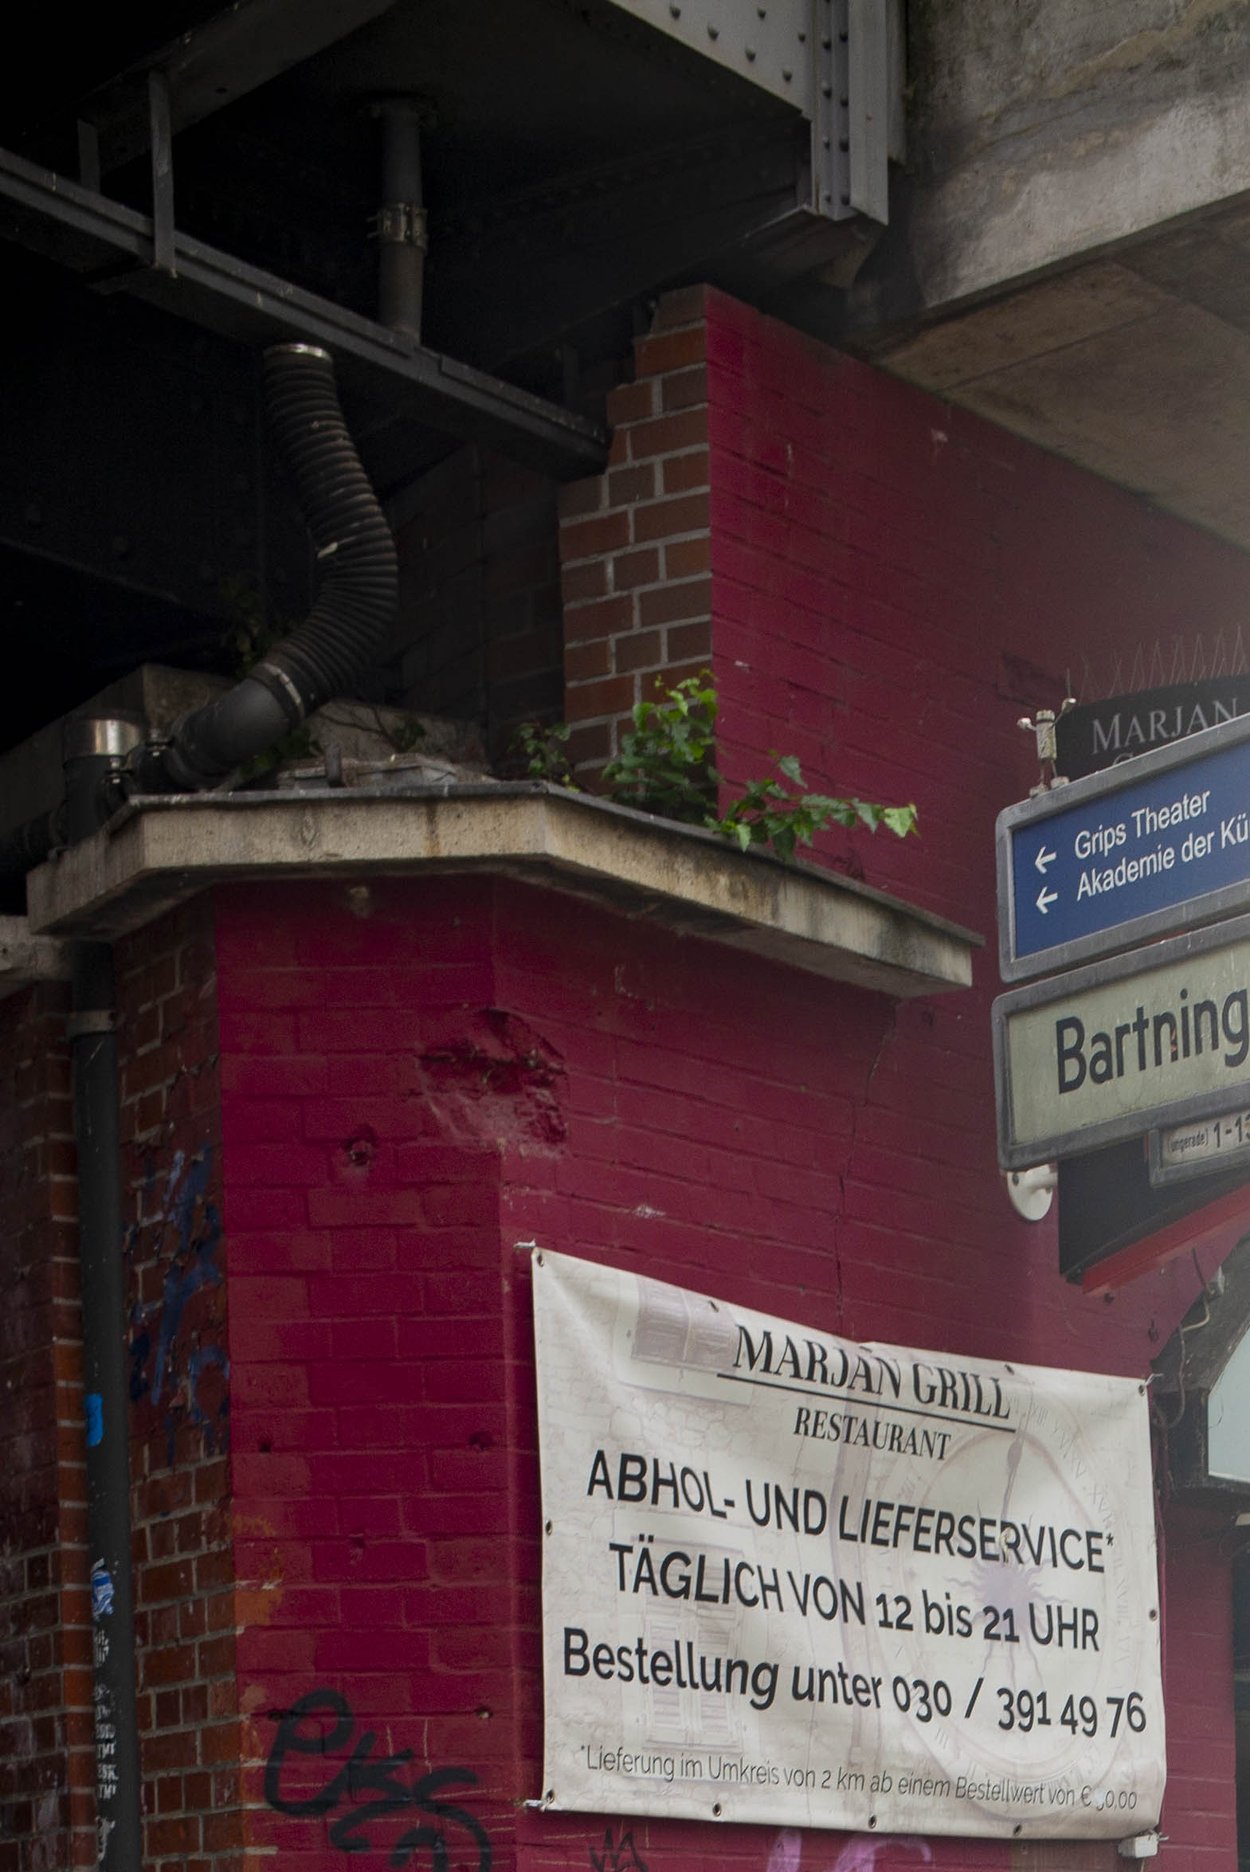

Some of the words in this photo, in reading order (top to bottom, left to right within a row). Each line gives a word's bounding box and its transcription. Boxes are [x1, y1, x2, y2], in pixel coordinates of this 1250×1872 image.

[1092, 698, 1239, 755] MARJAN
[1074, 820, 1127, 862] Grips
[1131, 789, 1212, 841] Theater
[1076, 844, 1175, 903] Akademie
[1180, 830, 1214, 862] der
[732, 1324, 902, 1400] MARJAN
[911, 1362, 1011, 1420] GRILL
[793, 1405, 952, 1461] RESTAURANT
[587, 1449, 736, 1519] ABHOL-
[745, 1479, 828, 1535] UND
[609, 1533, 785, 1612] TÄGLICH
[787, 1570, 866, 1627] VON
[875, 1592, 914, 1632] 12
[922, 1589, 973, 1638] bis
[982, 1605, 1020, 1643] 21
[1028, 1601, 1101, 1652] UHR
[564, 1627, 780, 1711] Bestellung
[791, 1661, 883, 1709] unter
[891, 1674, 952, 1723] 030
[963, 1676, 985, 1720] /
[996, 1687, 1053, 1733] 391
[1060, 1693, 1098, 1738] 49
[1105, 1691, 1147, 1738] 76
[680, 1752, 703, 1779] im
[708, 1756, 780, 1786] Umkreis
[783, 1767, 817, 1789] von
[820, 1769, 832, 1790] 2
[837, 1766, 866, 1792] km
[870, 1770, 893, 1794] ab
[898, 1771, 951, 1797] einem
[955, 1775, 1046, 1805] Bestellwert
[1049, 1786, 1075, 1806] von
[1079, 1785, 1093, 1808] €
[1096, 1789, 1138, 1812] 0,00
